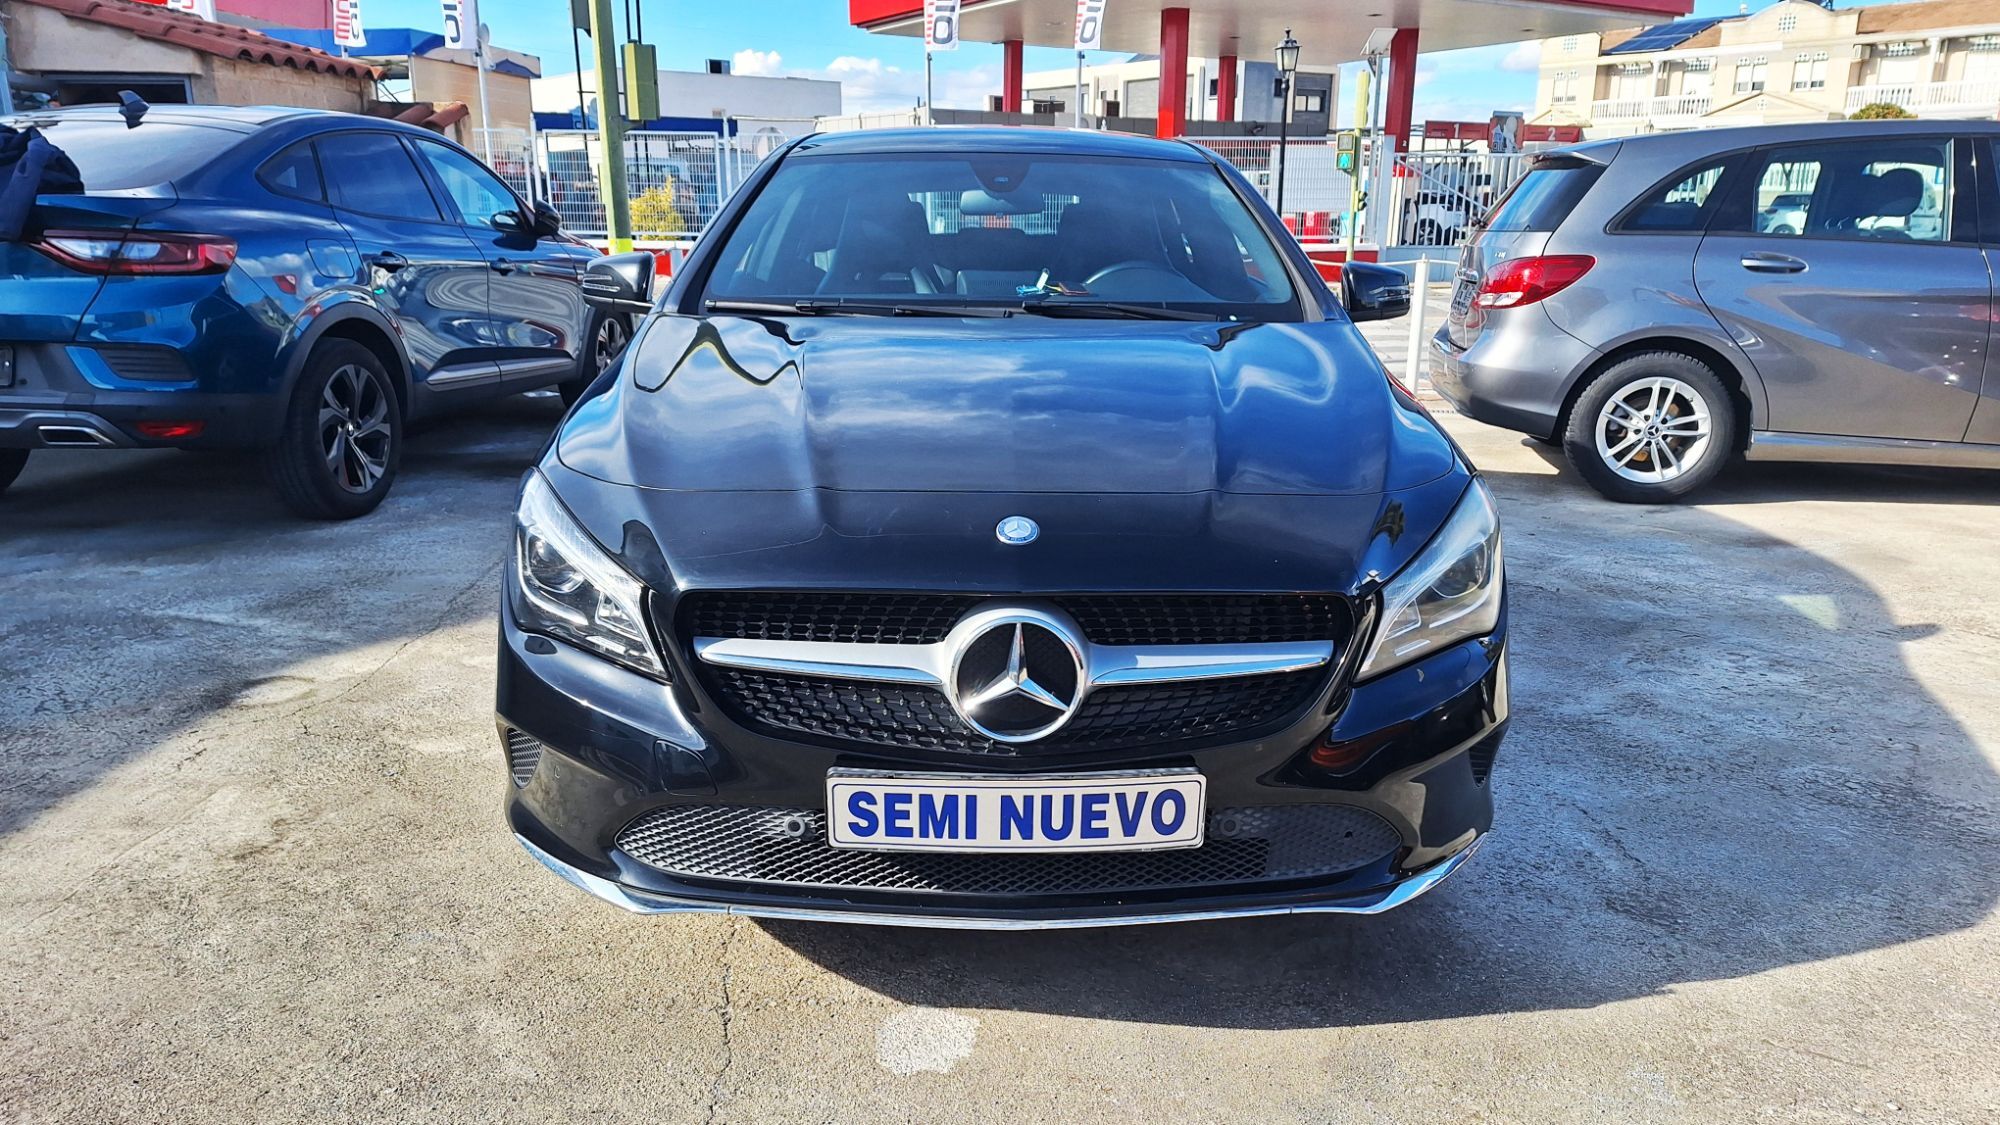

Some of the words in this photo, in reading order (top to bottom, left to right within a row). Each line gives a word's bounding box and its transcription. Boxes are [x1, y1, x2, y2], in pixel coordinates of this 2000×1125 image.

[1453, 123, 1460, 139] 1
[1547, 127, 1556, 141] 2
[848, 791, 977, 840] SEMI
[999, 789, 1186, 840] NUEVO
